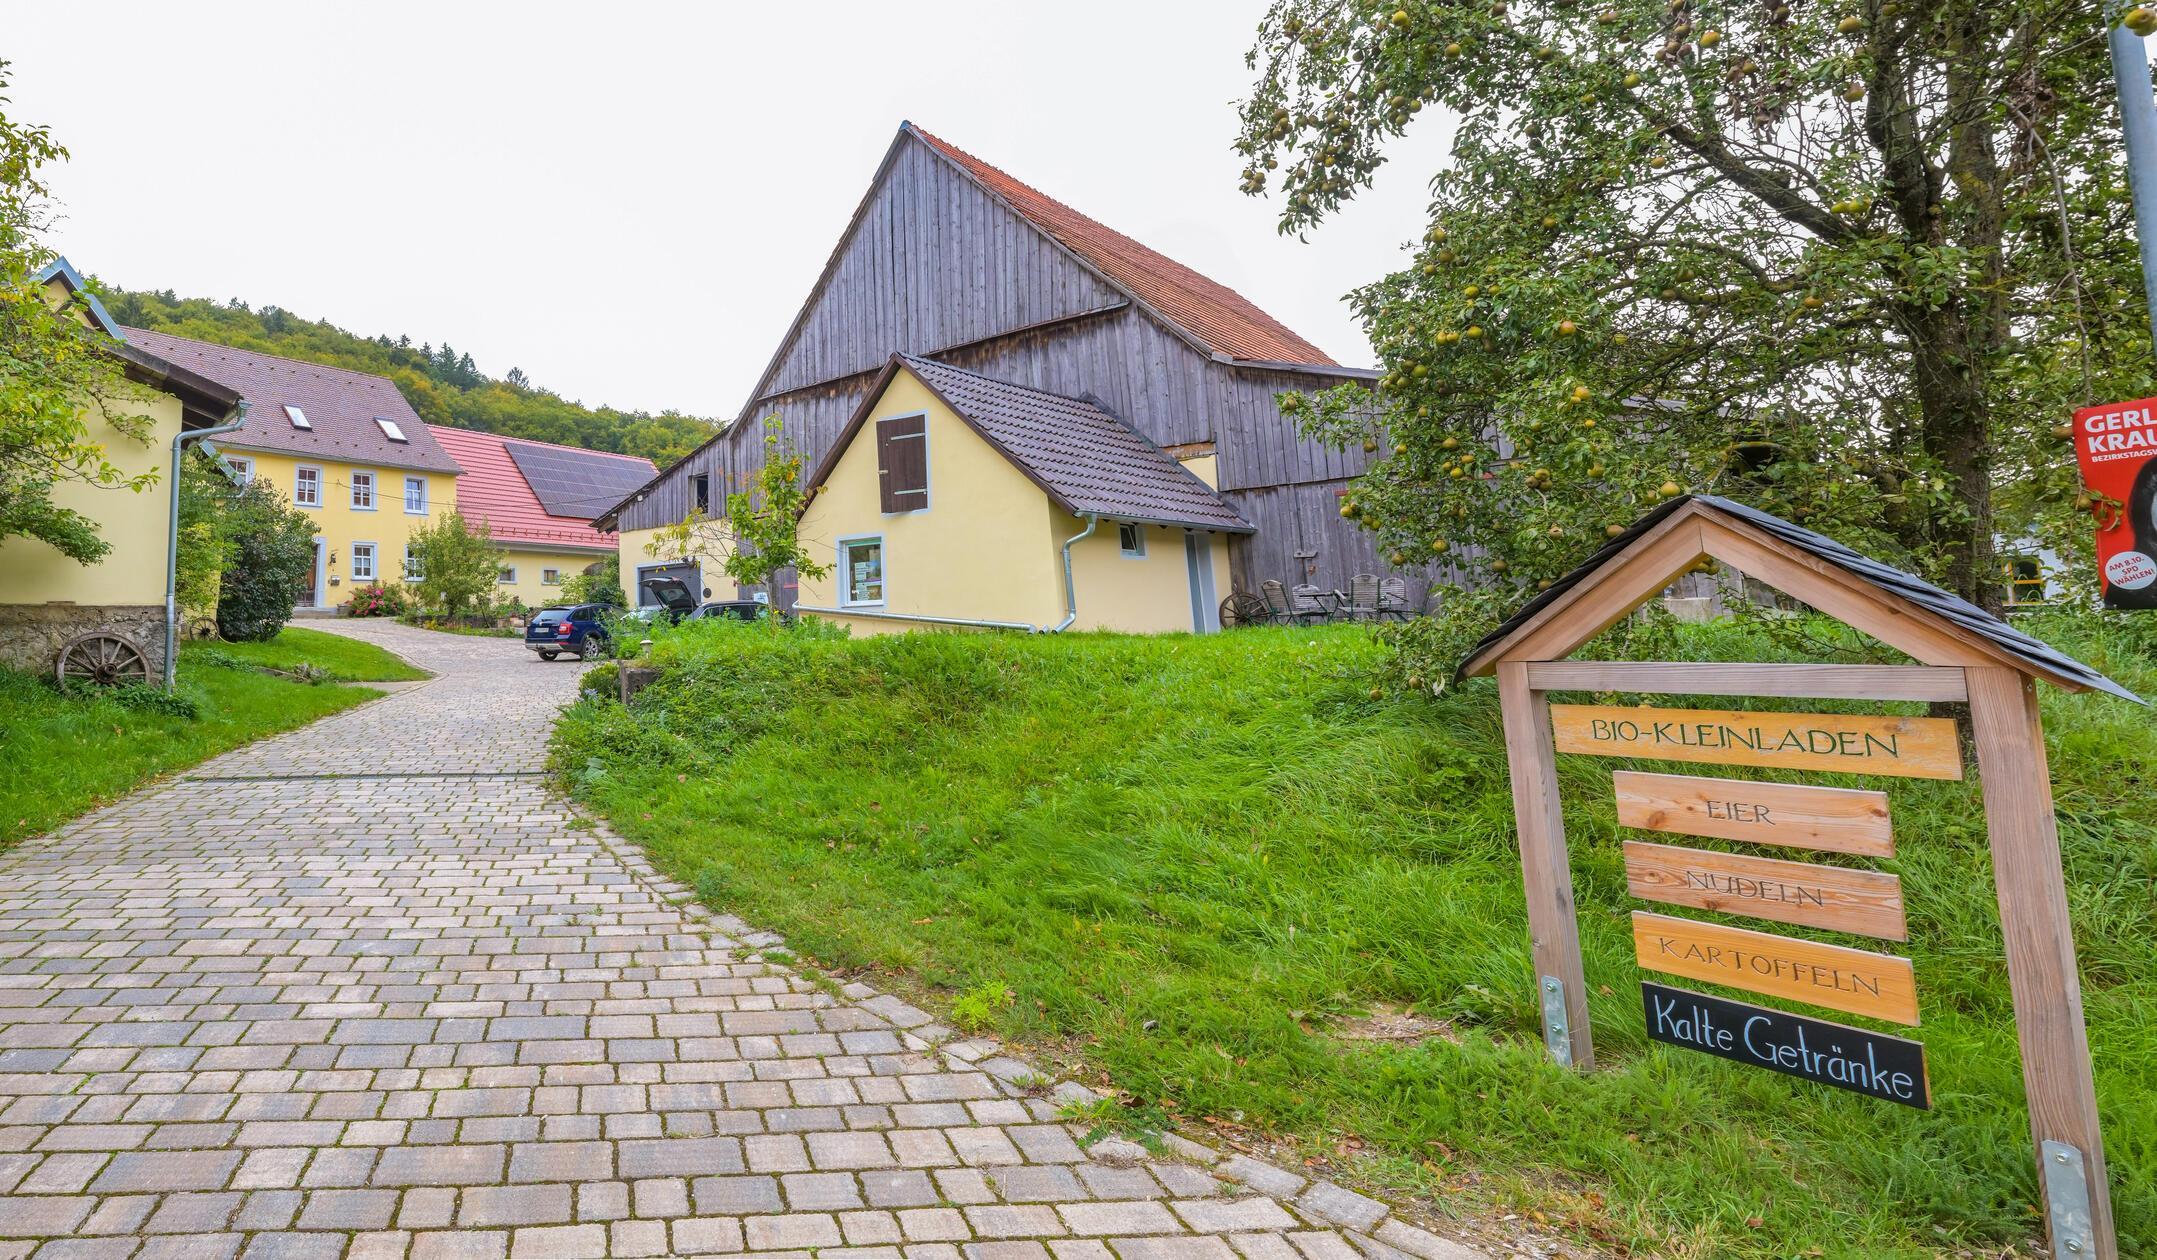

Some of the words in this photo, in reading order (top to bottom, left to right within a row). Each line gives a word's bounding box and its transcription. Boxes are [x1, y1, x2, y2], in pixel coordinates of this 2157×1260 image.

[2109, 562, 2124, 571] AM
[2114, 568, 2156, 585] WÄHLEN!
[2121, 565, 2139, 575] SPD
[1591, 719, 1898, 758] BIO-KLEINLADEN
[1707, 800, 1776, 826] EIER
[1686, 870, 1823, 908] NUDELN
[1660, 937, 1880, 998] KARTOFFELN
[1654, 994, 1733, 1050] Kalte
[1744, 1015, 1913, 1099] Getränke
